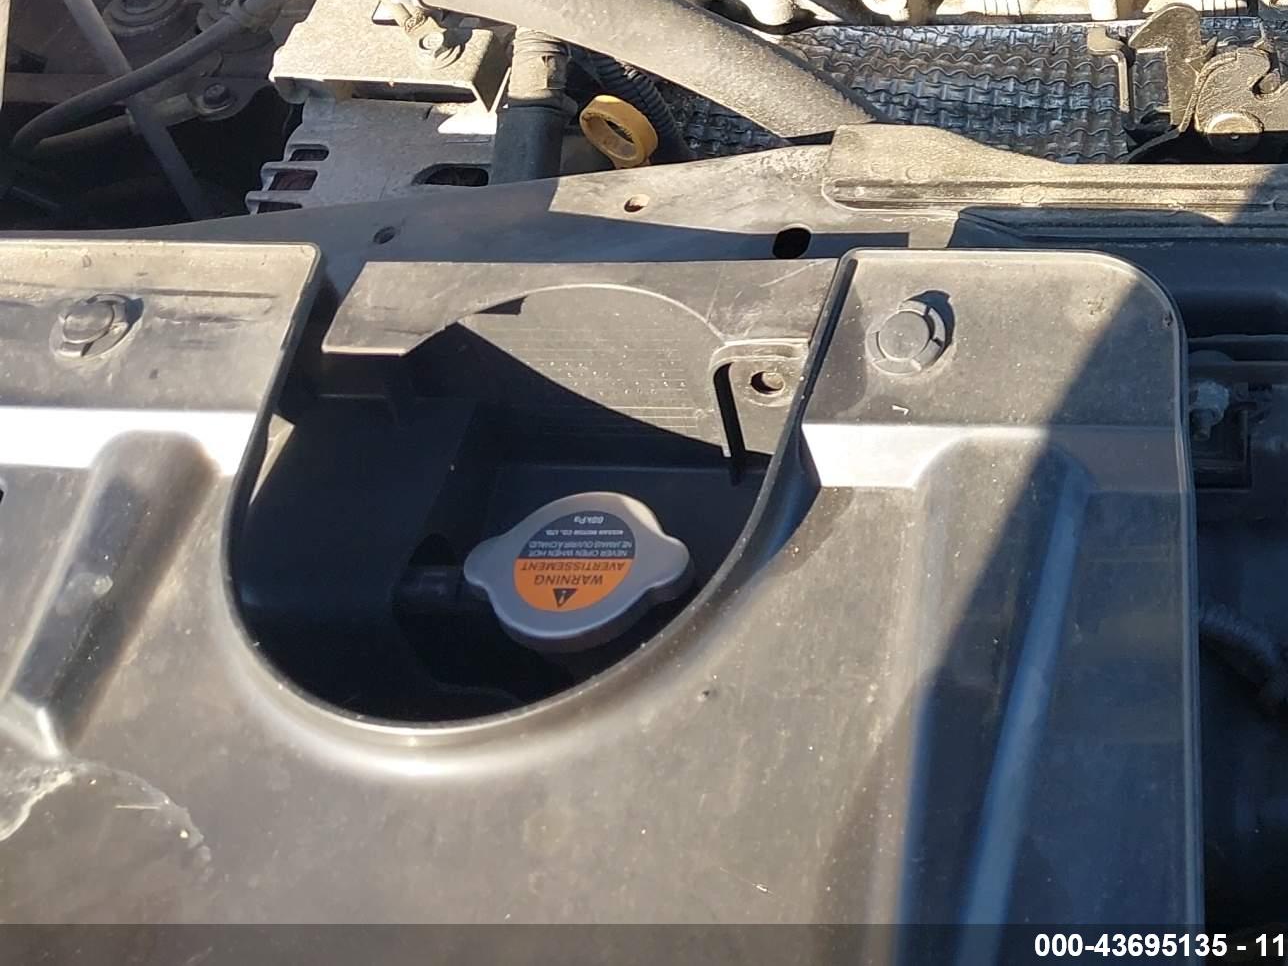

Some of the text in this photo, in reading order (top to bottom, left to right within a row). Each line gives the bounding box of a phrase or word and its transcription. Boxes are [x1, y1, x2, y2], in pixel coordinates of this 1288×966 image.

[563, 540, 594, 548] OUVRIR
[594, 540, 621, 548] JAMAIS
[621, 540, 632, 548] NE
[547, 549, 574, 557] WHEN
[519, 561, 625, 571] AVERTISSEMENT
[533, 575, 604, 586] WARNING
